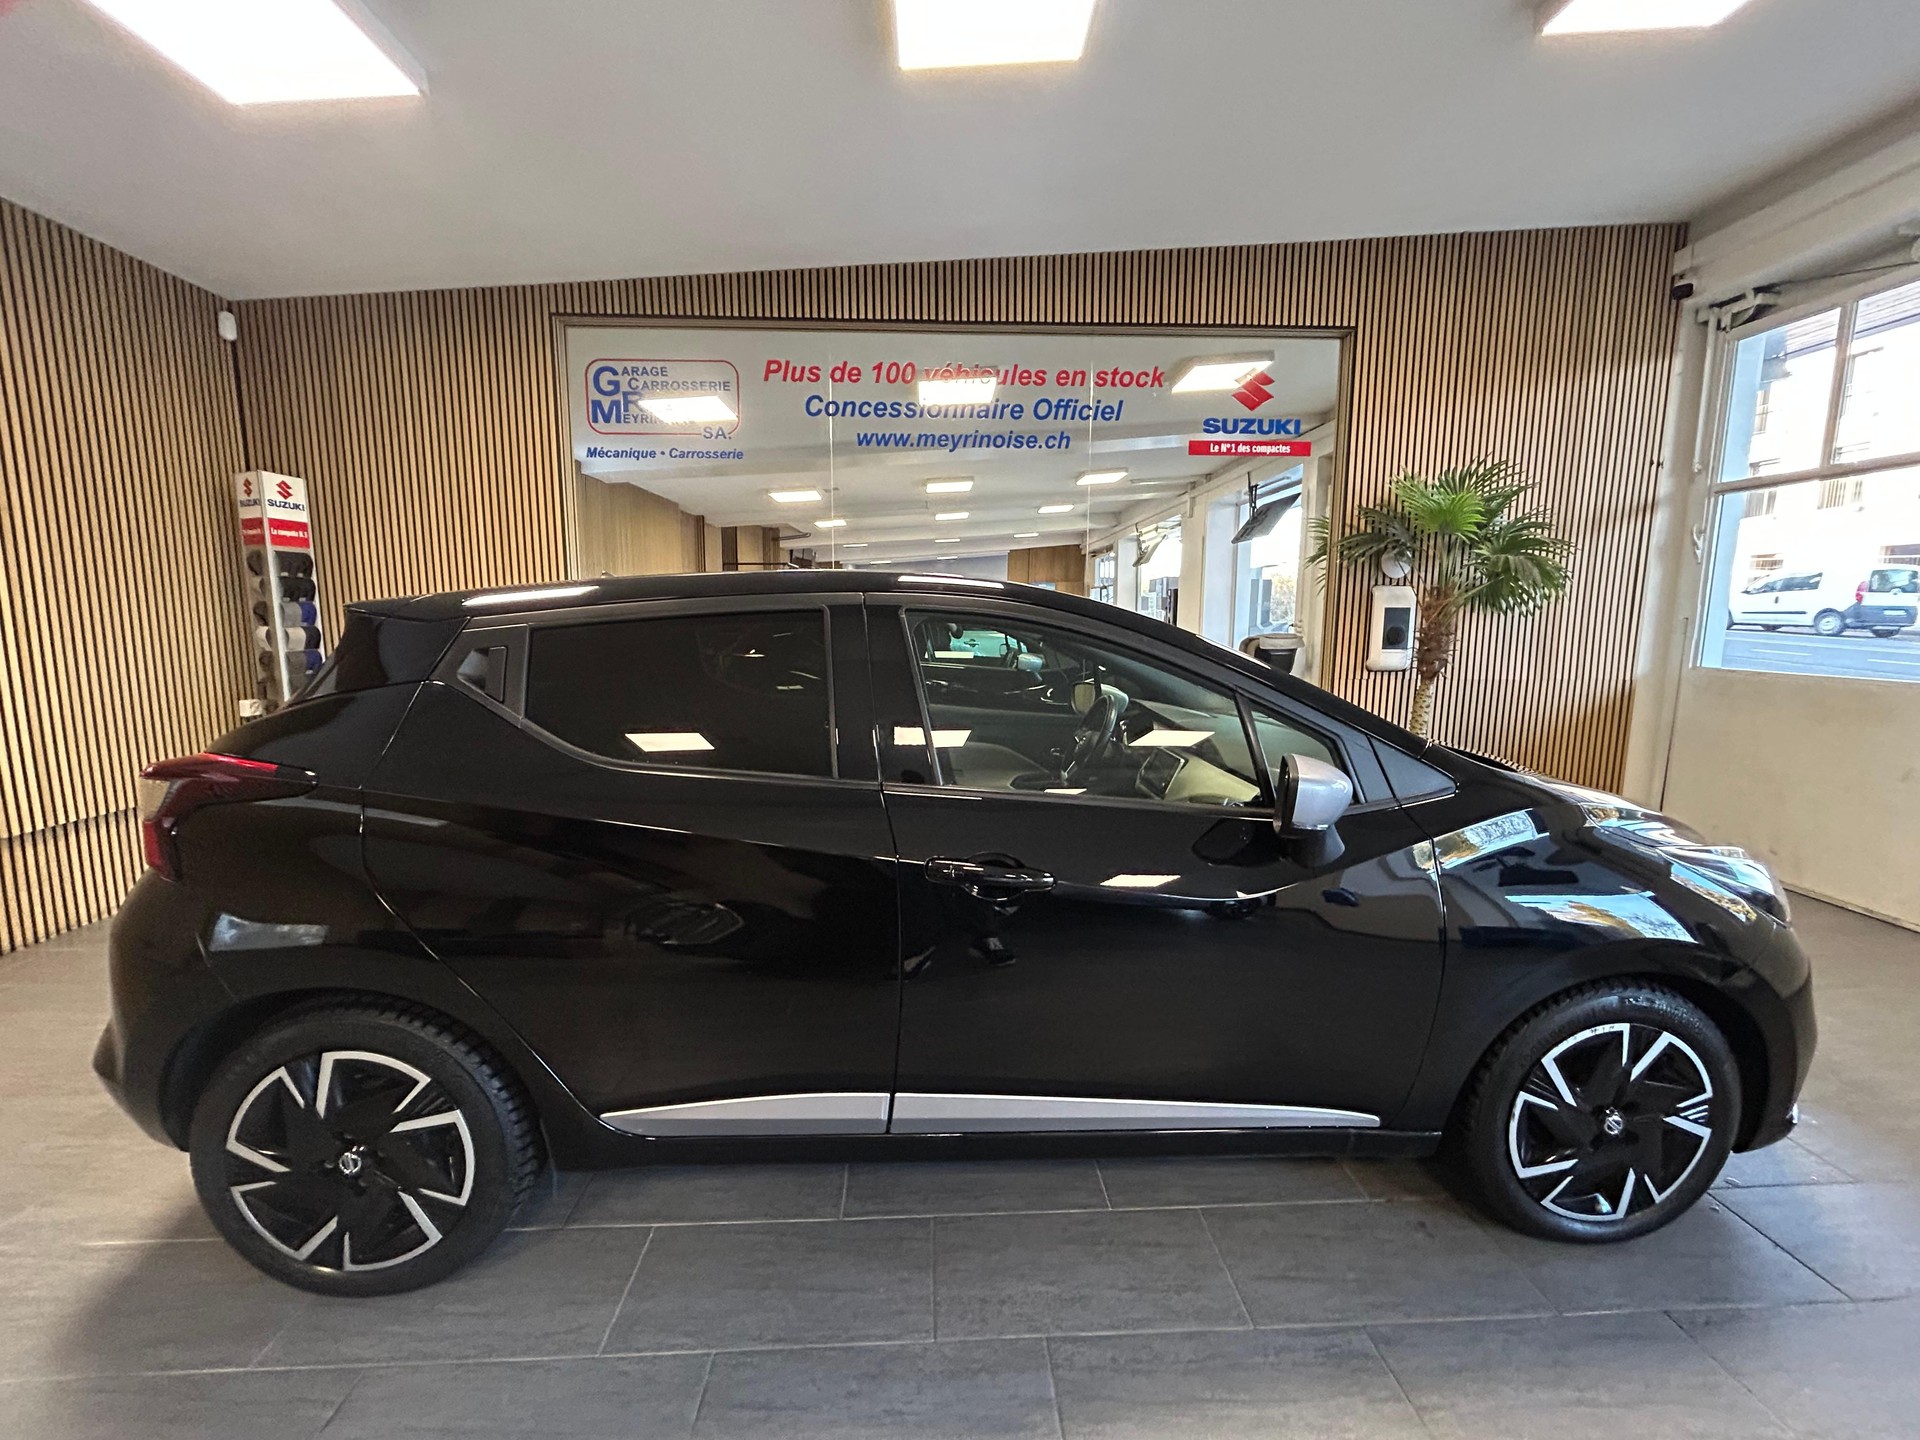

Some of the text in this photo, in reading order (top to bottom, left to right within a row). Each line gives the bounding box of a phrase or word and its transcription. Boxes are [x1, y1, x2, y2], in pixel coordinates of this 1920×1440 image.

[763, 359, 1165, 388] Plus de 100 véhicules en stock
[627, 377, 731, 392] CARROSSERIE
[804, 394, 1124, 421] Concessionnaire Officiel
[1203, 418, 1301, 435] SUZUKI
[856, 430, 1071, 453] www.meyrinoise.ch
[1210, 443, 1219, 452] Le
[1237, 443, 1250, 453] des
[1252, 444, 1291, 454] compactes
[586, 446, 744, 461] Mécanique Carrosserie
[267, 499, 305, 511] SUZUKI
